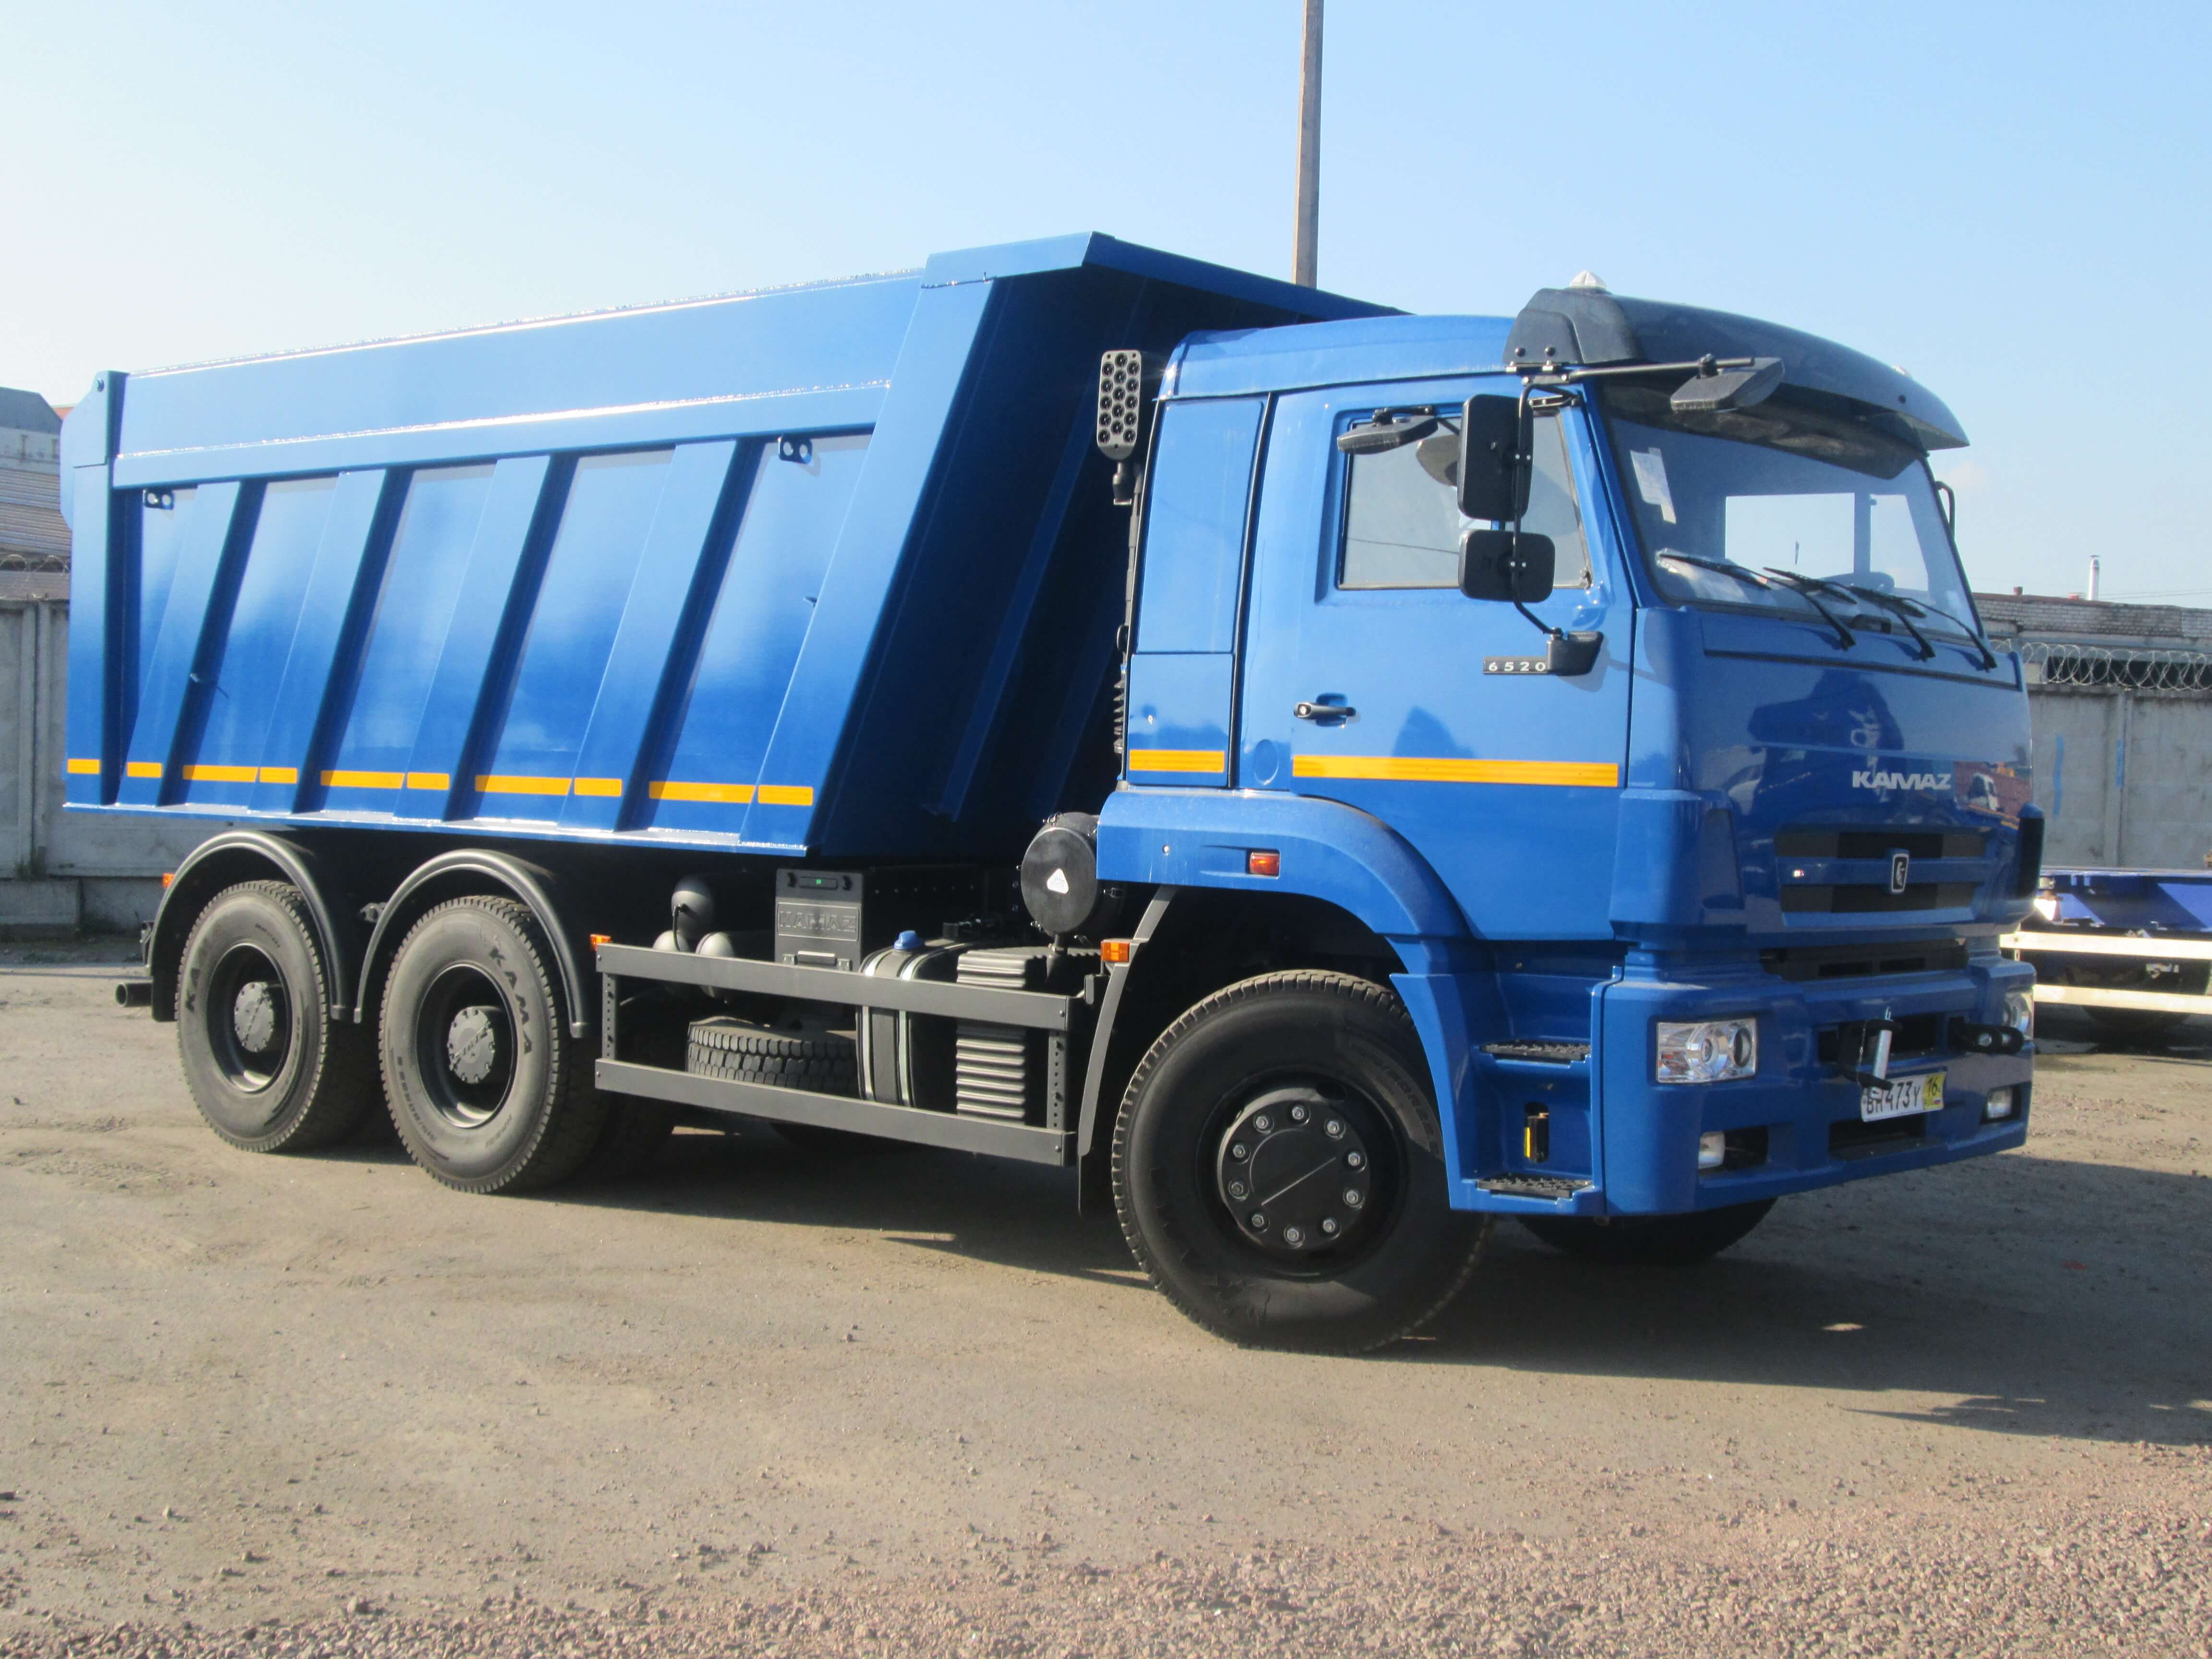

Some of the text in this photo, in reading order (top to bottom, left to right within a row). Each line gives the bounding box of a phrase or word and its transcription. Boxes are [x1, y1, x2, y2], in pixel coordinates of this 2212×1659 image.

[1488, 661, 1546, 672] 6520
[1852, 770, 1951, 790] KAMAZ
[779, 911, 856, 933] KAMAZ
[488, 944, 532, 1055] KAMA
